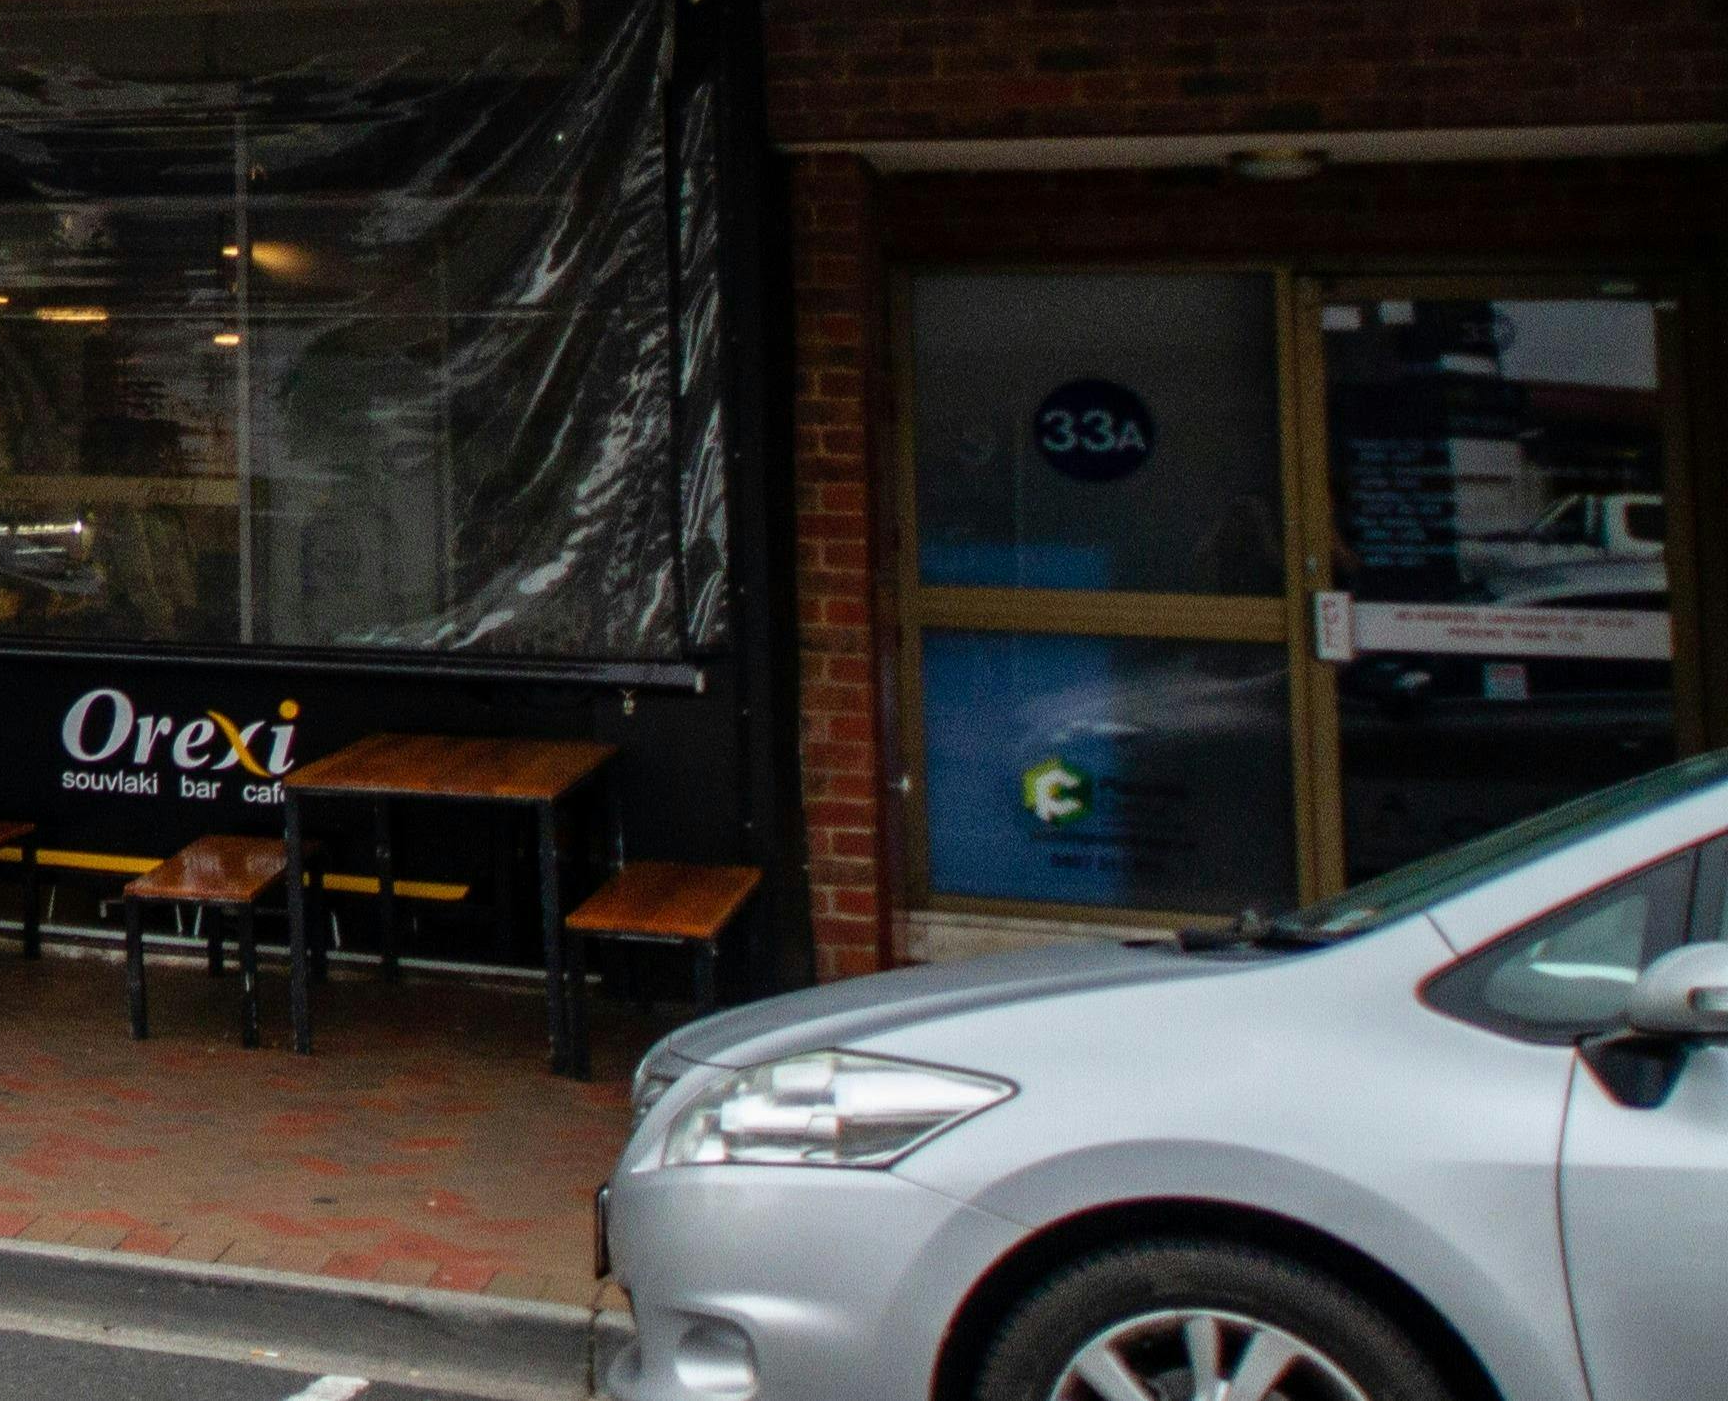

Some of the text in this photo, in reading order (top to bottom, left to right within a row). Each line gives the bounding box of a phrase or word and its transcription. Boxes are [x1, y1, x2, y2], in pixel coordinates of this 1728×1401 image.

[1043, 409, 1145, 452] 33A
[61, 688, 300, 779] Orexi
[61, 769, 159, 795] souvlaki
[180, 775, 221, 800] bar
